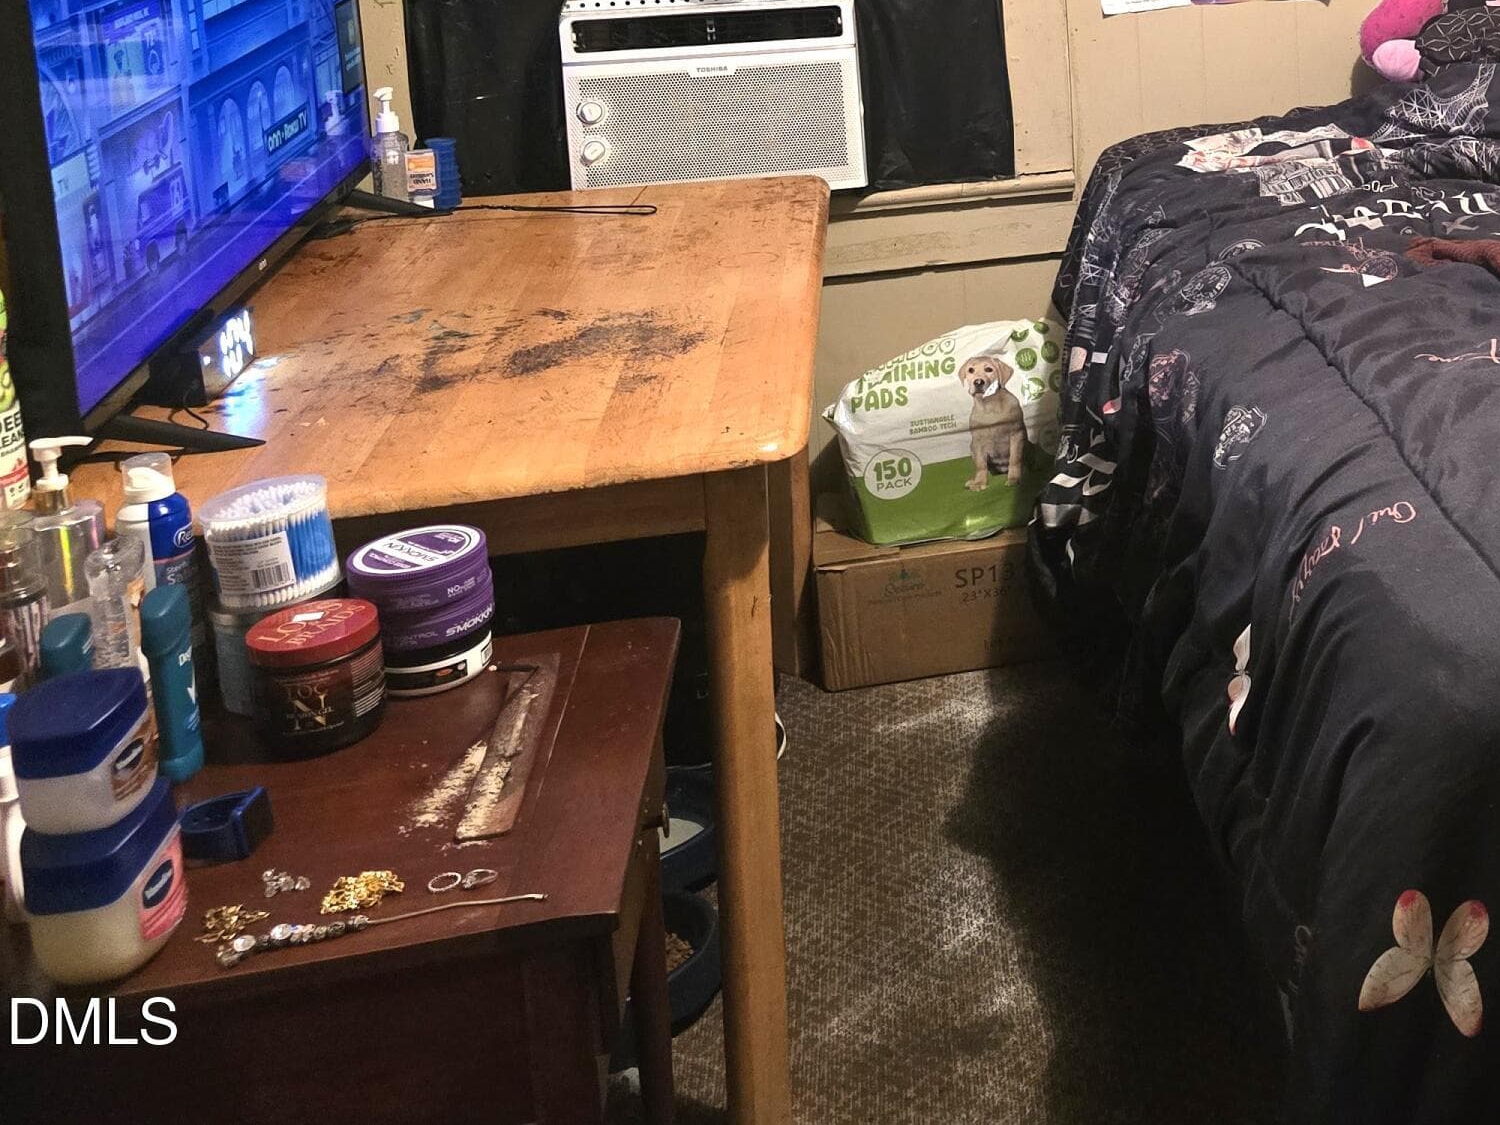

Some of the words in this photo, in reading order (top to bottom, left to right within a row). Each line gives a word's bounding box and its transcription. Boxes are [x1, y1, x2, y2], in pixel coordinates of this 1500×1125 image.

[851, 386, 909, 413] PADS
[873, 457, 913, 482] 150
[877, 478, 913, 492] PACK
